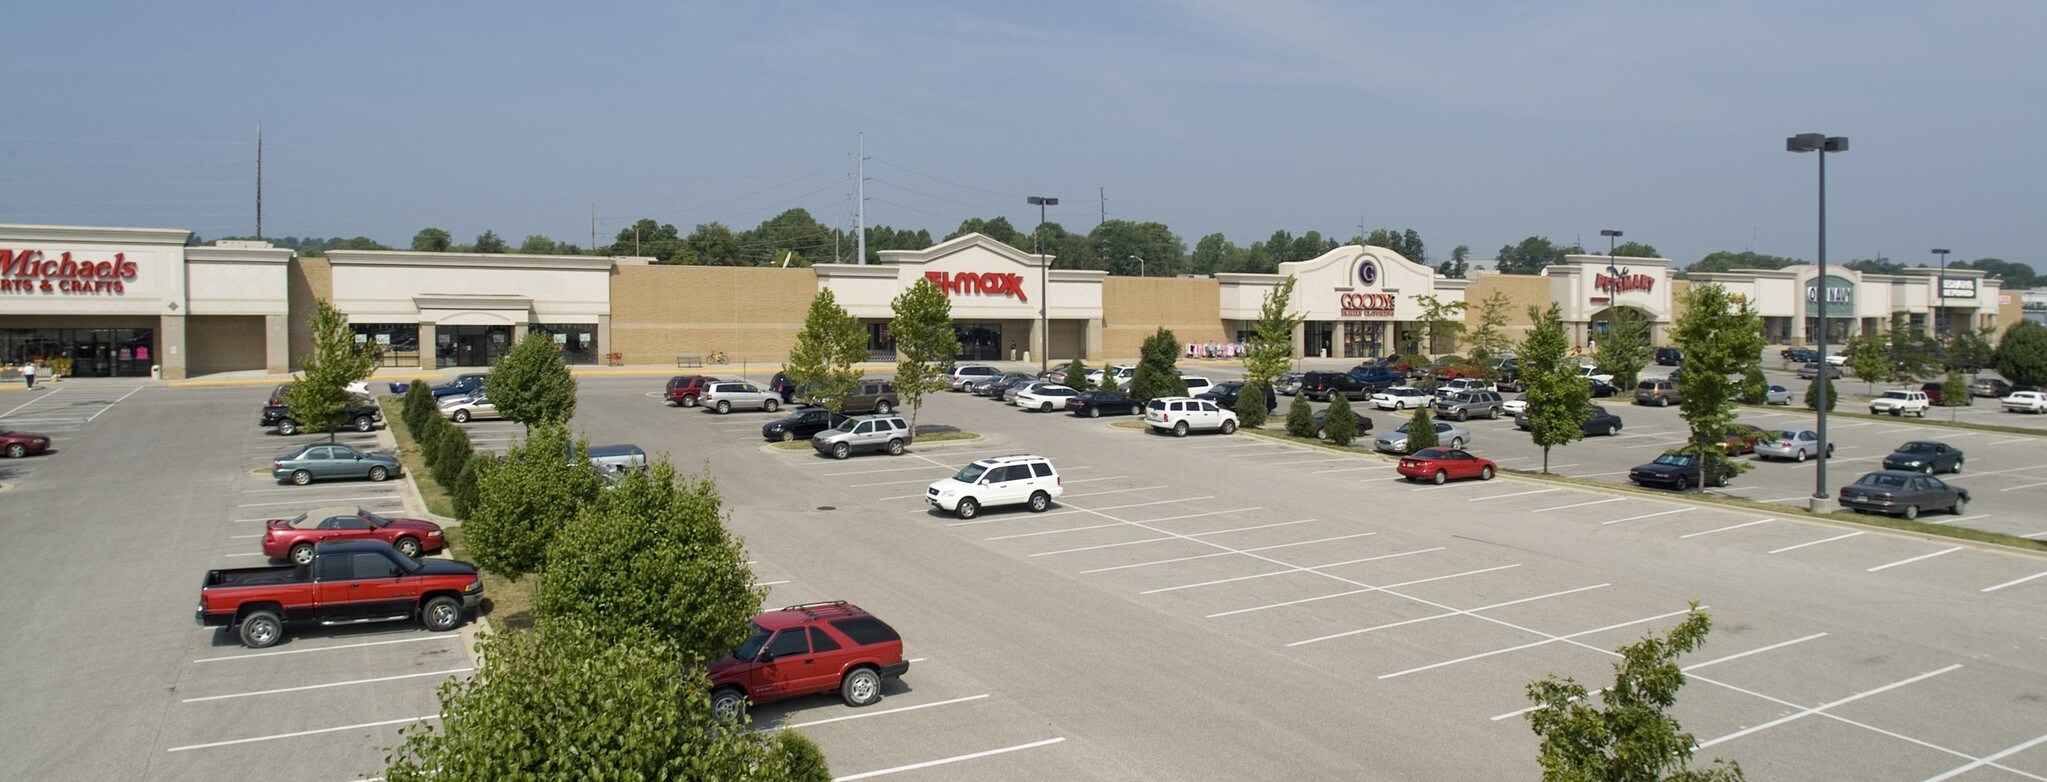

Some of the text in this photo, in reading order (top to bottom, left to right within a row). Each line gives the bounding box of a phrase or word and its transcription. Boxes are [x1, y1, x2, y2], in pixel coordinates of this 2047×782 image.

[0, 249, 137, 279] Michaels
[0, 279, 124, 293] RTS & CRAFTS
